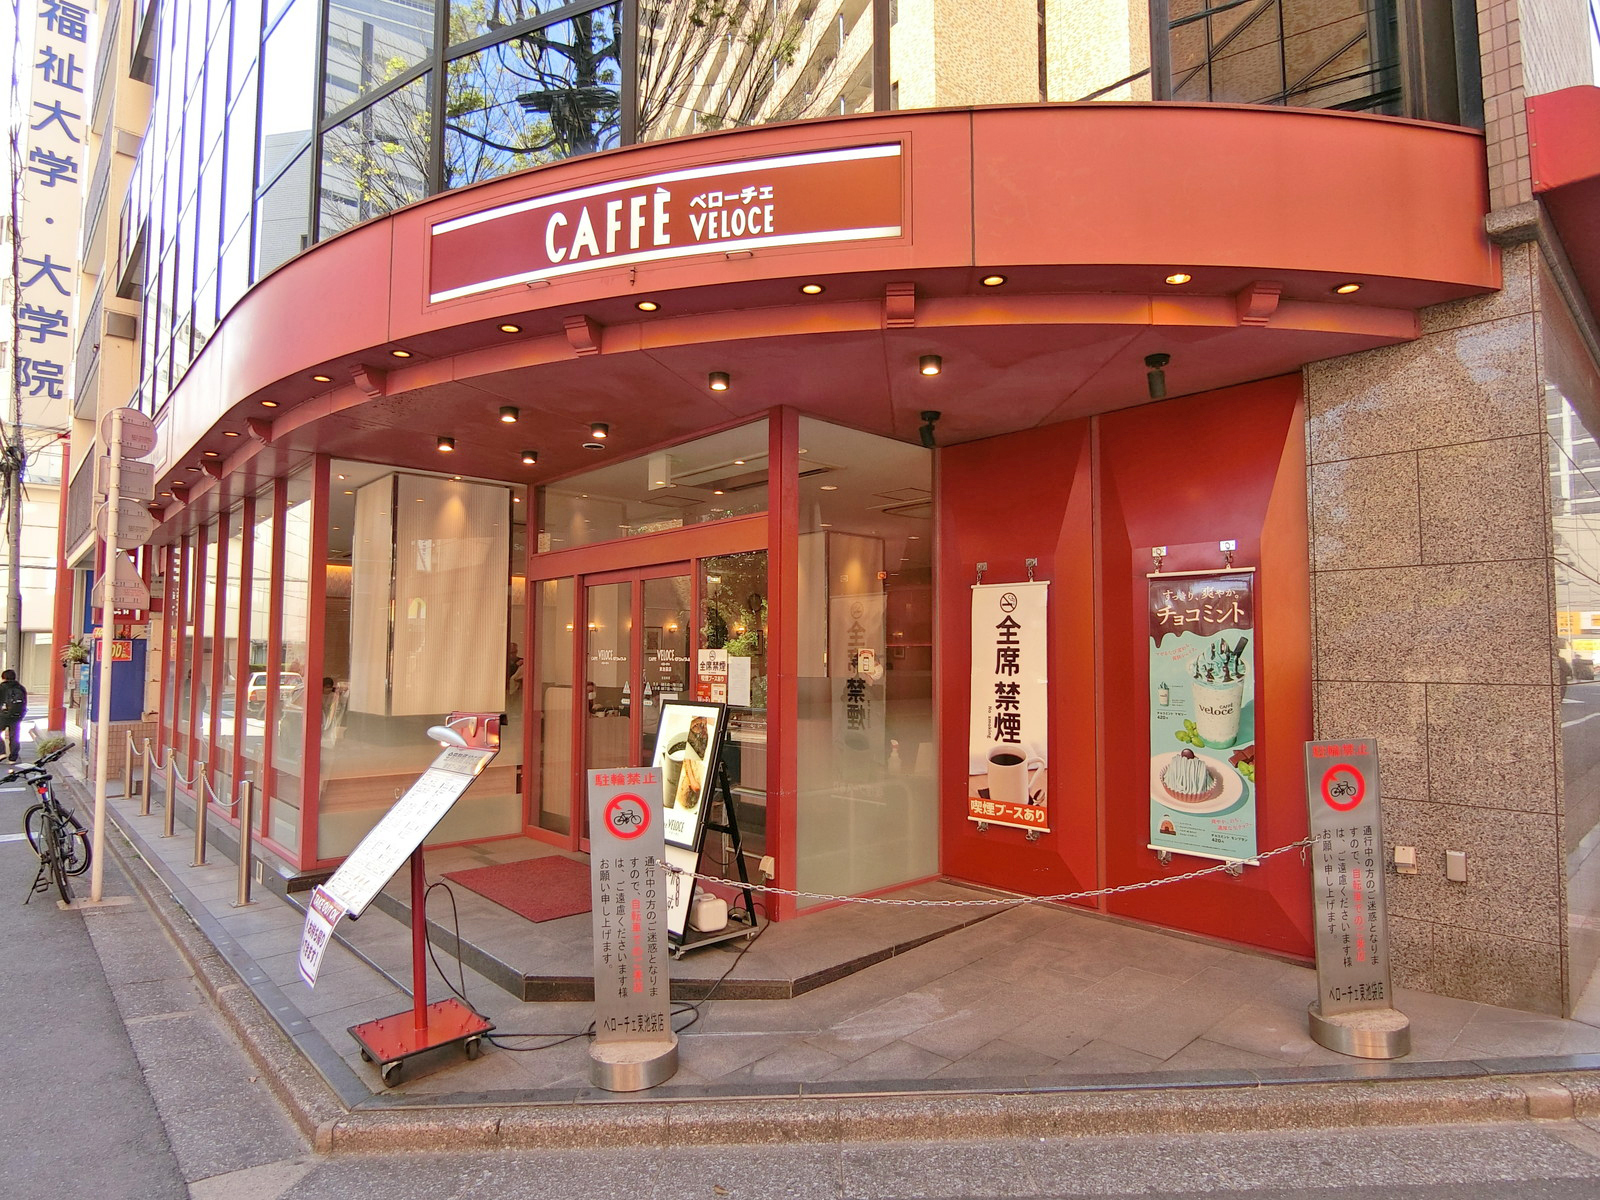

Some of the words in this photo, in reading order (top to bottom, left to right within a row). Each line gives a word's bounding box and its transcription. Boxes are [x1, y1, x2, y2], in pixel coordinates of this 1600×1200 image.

[689, 185, 774, 209] ベローチェ
[545, 187, 671, 264] CAFFÈ
[688, 203, 775, 242] VELOCE
[1156, 601, 1245, 626] チョコミント
[656, 649, 675, 661] VELOCE
[699, 660, 726, 672] 全席禁煙
[993, 614, 1021, 744] 全席禁煙
[1311, 742, 1369, 758] 駐輪禁止
[595, 772, 657, 786] 駐輪禁止
[668, 818, 685, 833] VELOCE
[969, 799, 1045, 823] 喫煙ブースあり
[1322, 829, 1337, 939] お願い申し上げます。
[1336, 828, 1353, 968] は、ご遠慮くださいます様
[1363, 825, 1379, 966] 通行中の方のご迷惑となりま
[600, 859, 613, 968] お願い申し上げます。
[614, 858, 628, 998] は、ご遠慮くださいます様
[644, 855, 659, 997] 通行中の方のご迷惑となりま
